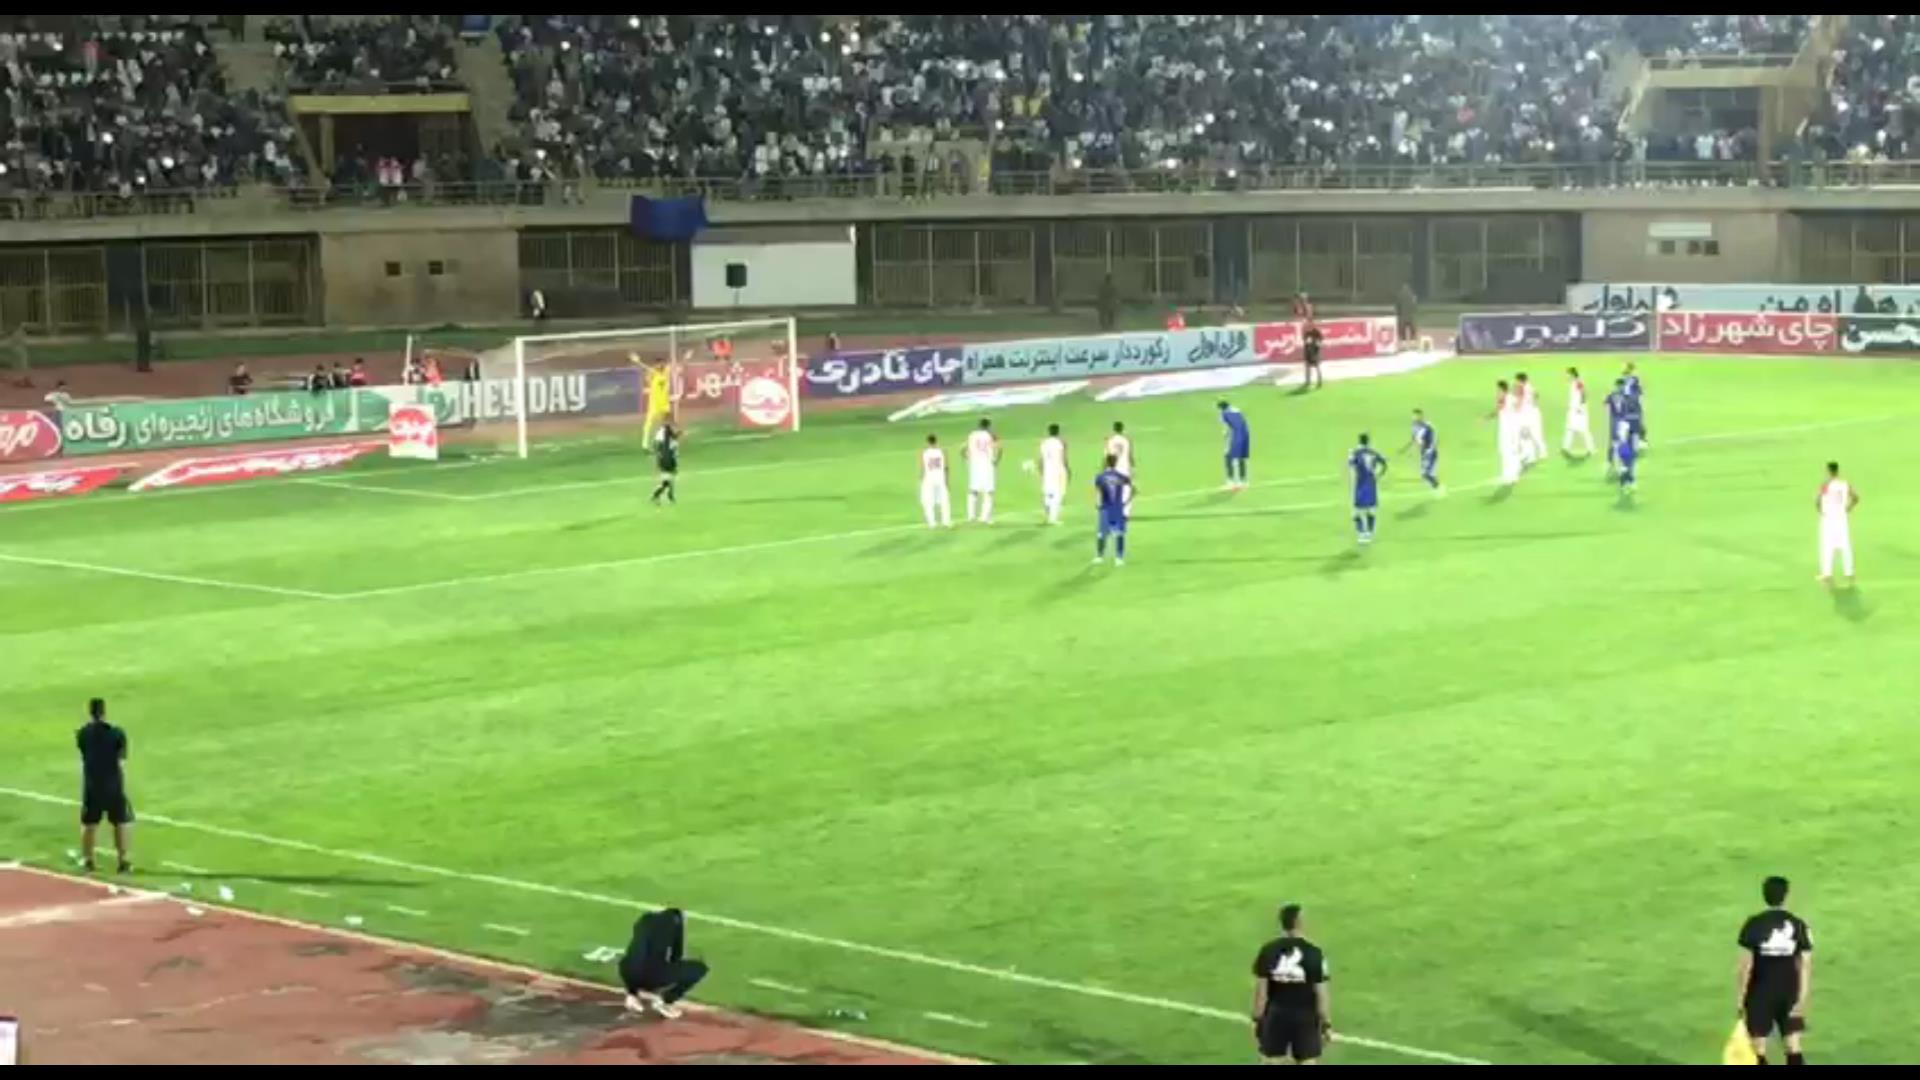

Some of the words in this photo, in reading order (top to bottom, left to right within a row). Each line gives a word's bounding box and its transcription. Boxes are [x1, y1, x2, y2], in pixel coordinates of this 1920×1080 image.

[1662, 313, 1776, 346] شهرزاد
[1778, 313, 1834, 350] چای
[806, 351, 908, 393] نادری
[913, 351, 963, 383] چای
[1009, 344, 1063, 373] اینترنت
[1065, 347, 1109, 370] سرعت
[462, 379, 520, 418] HEY
[529, 374, 587, 414] DAY
[66, 405, 128, 448] رفاه
